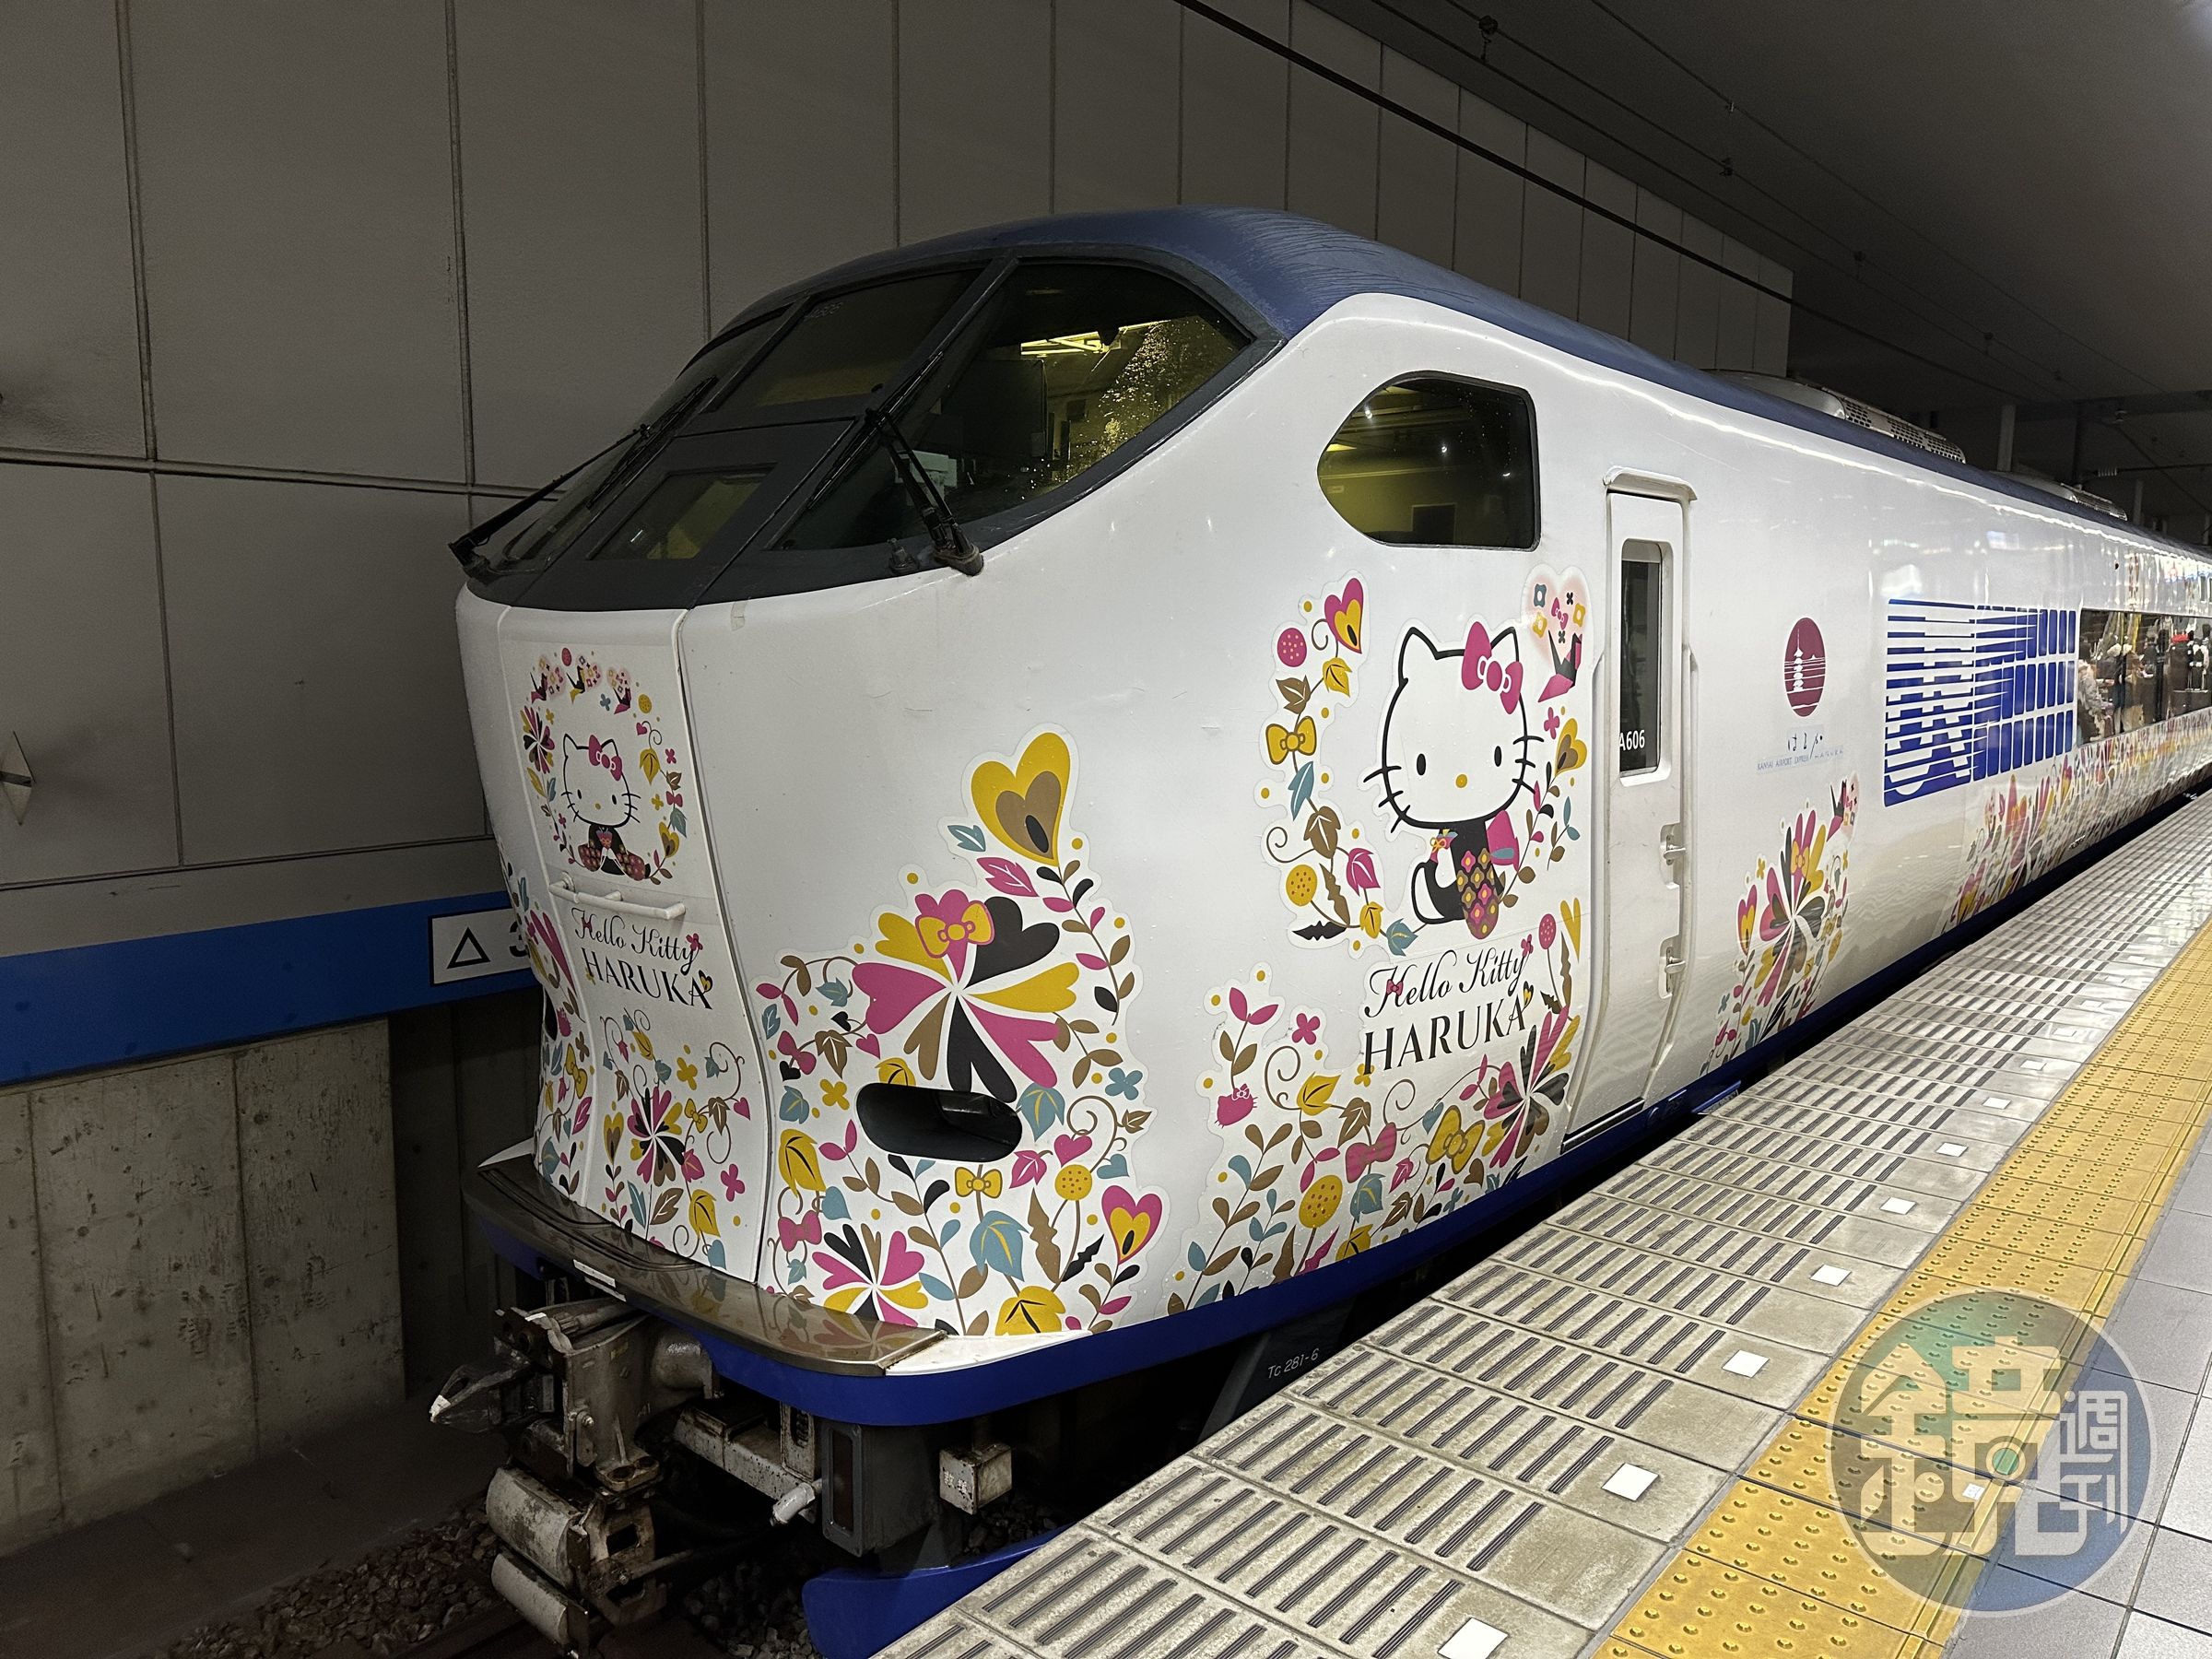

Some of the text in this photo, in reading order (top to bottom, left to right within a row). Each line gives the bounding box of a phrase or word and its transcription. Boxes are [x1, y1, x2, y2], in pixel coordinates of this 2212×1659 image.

[1618, 729, 1645, 751] A606
[571, 907, 700, 976] Hello Kitty
[581, 947, 712, 1010] HARUKA
[1364, 947, 1530, 1018] Hello Kitty
[1364, 994, 1526, 1076] HARUKA
